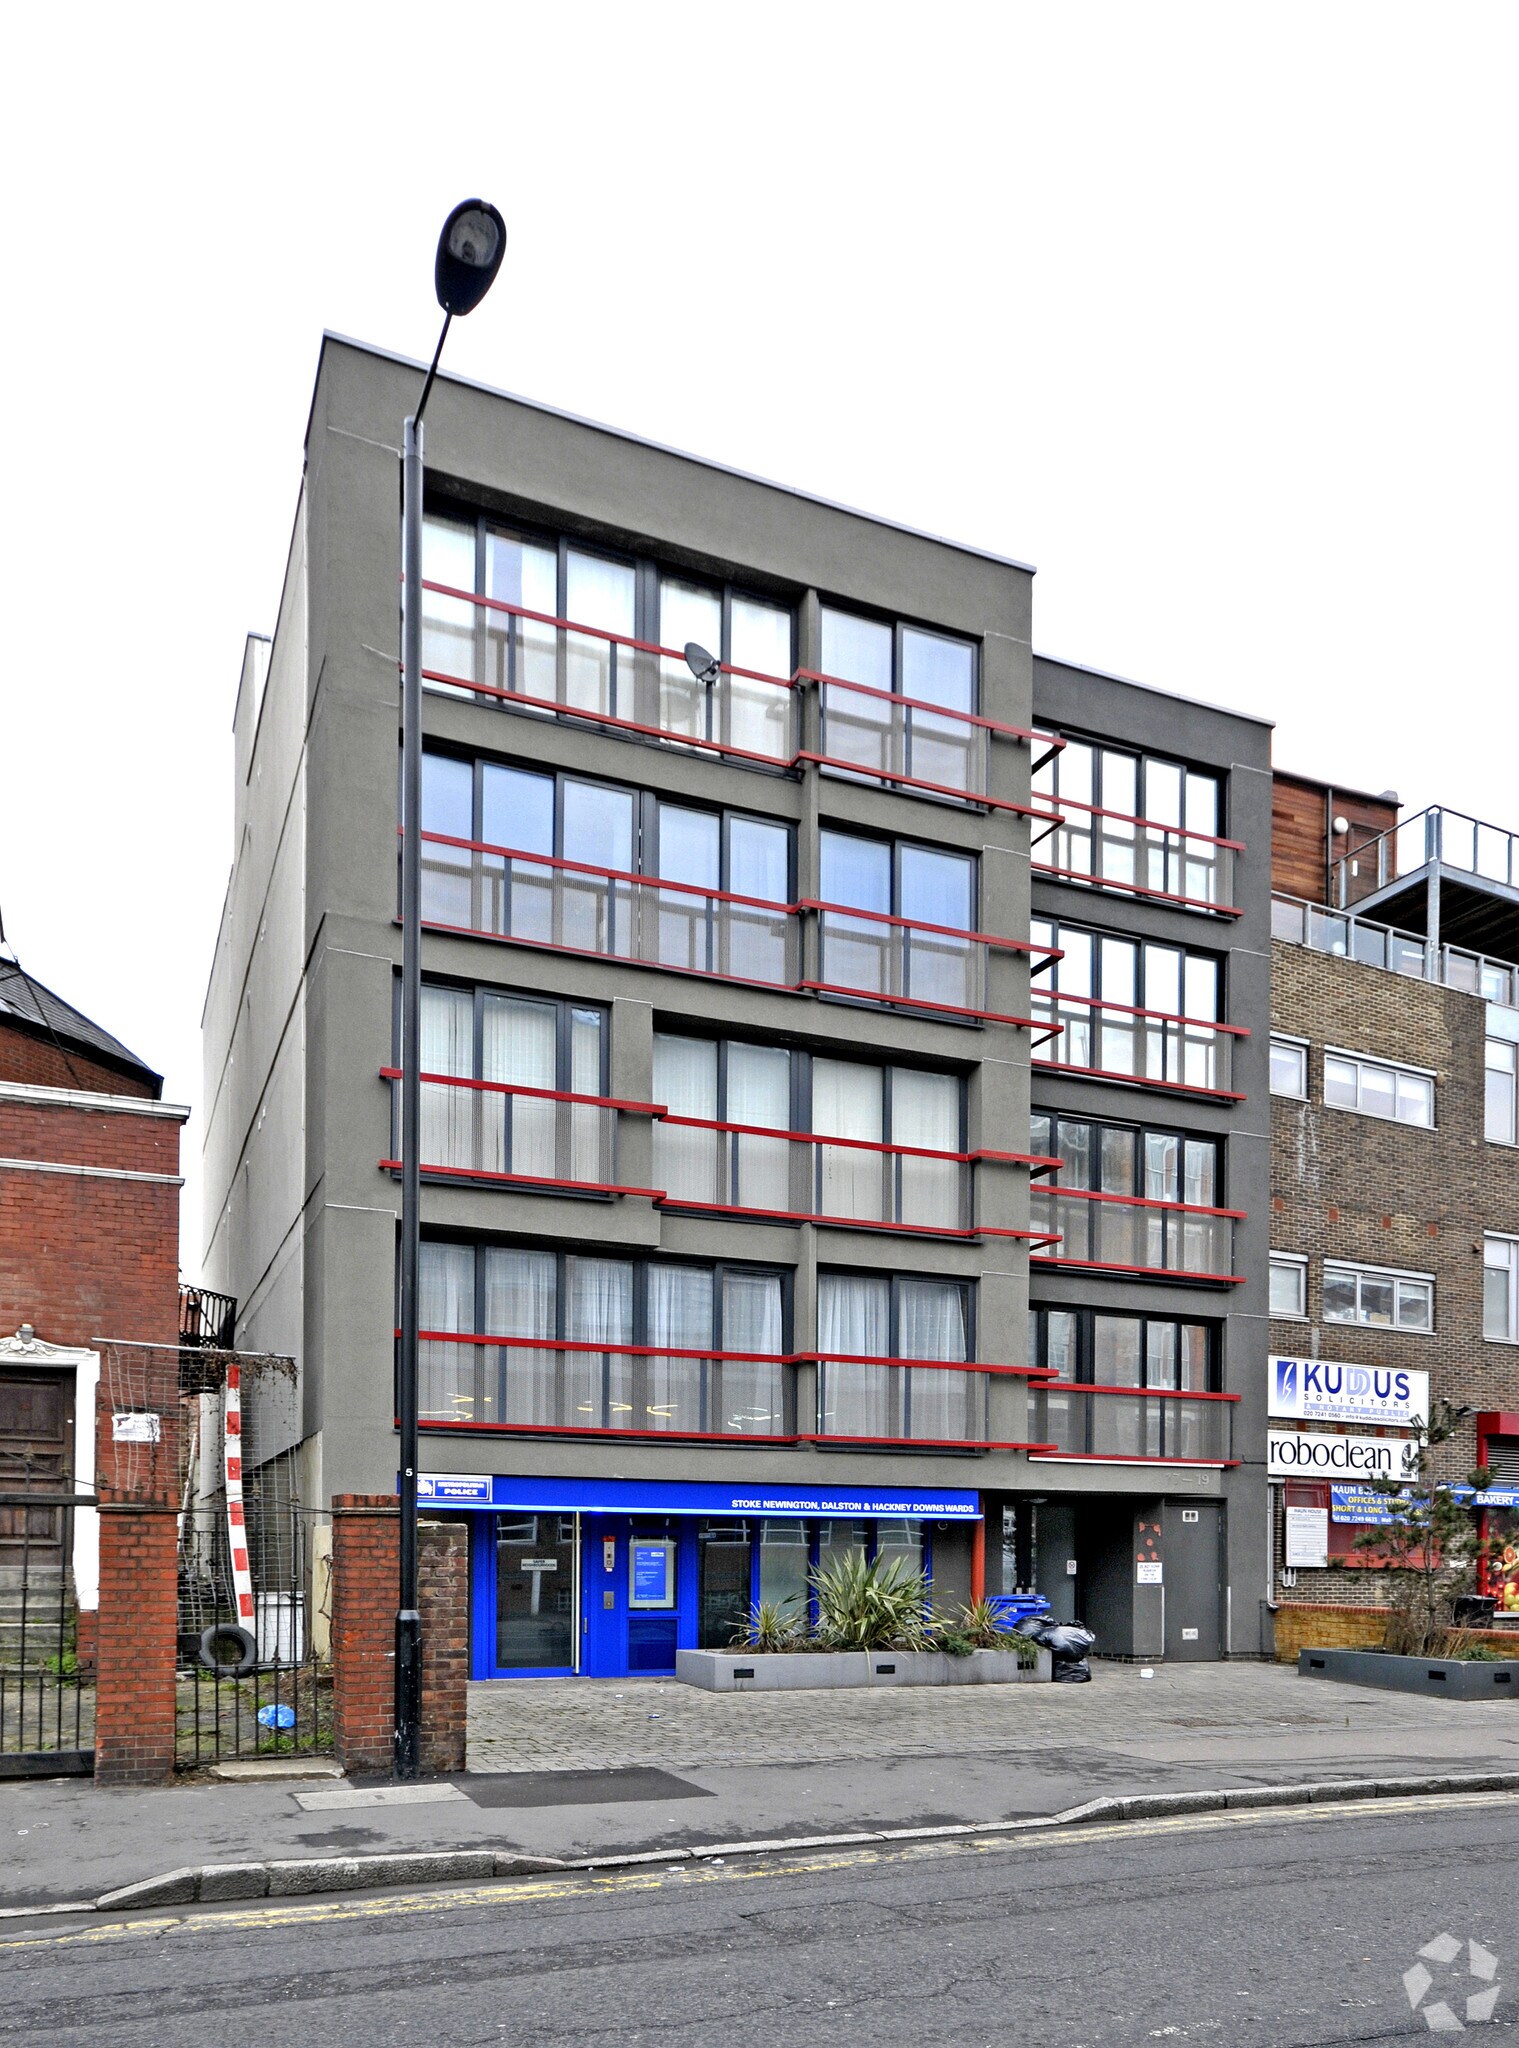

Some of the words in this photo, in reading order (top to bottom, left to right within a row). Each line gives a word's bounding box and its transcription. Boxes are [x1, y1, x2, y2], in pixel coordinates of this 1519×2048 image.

[1304, 1363, 1410, 1400] KUDDUS
[1304, 1394, 1410, 1408] SOLICITORS
[1319, 1404, 1361, 1413] NOTARY
[1369, 1408, 1409, 1417] PUBLIC
[1270, 1436, 1391, 1470] roboclean
[405, 1468, 413, 1477] 5
[444, 1488, 478, 1496] POLICE
[731, 1499, 761, 1508] STOKE
[763, 1500, 820, 1510] NEWINGTON,
[821, 1501, 861, 1510] DALSTON
[863, 1502, 870, 1510] &
[872, 1503, 911, 1511] HACKNEY
[913, 1504, 944, 1512] DOWNS
[945, 1504, 974, 1512] WARDS
[1348, 1496, 1375, 1504] OFFICES
[1376, 1497, 1382, 1505] &
[1476, 1495, 1514, 1505] BAKERY
[1332, 1504, 1355, 1513] SHORT
[1364, 1506, 1383, 1514] LONG
